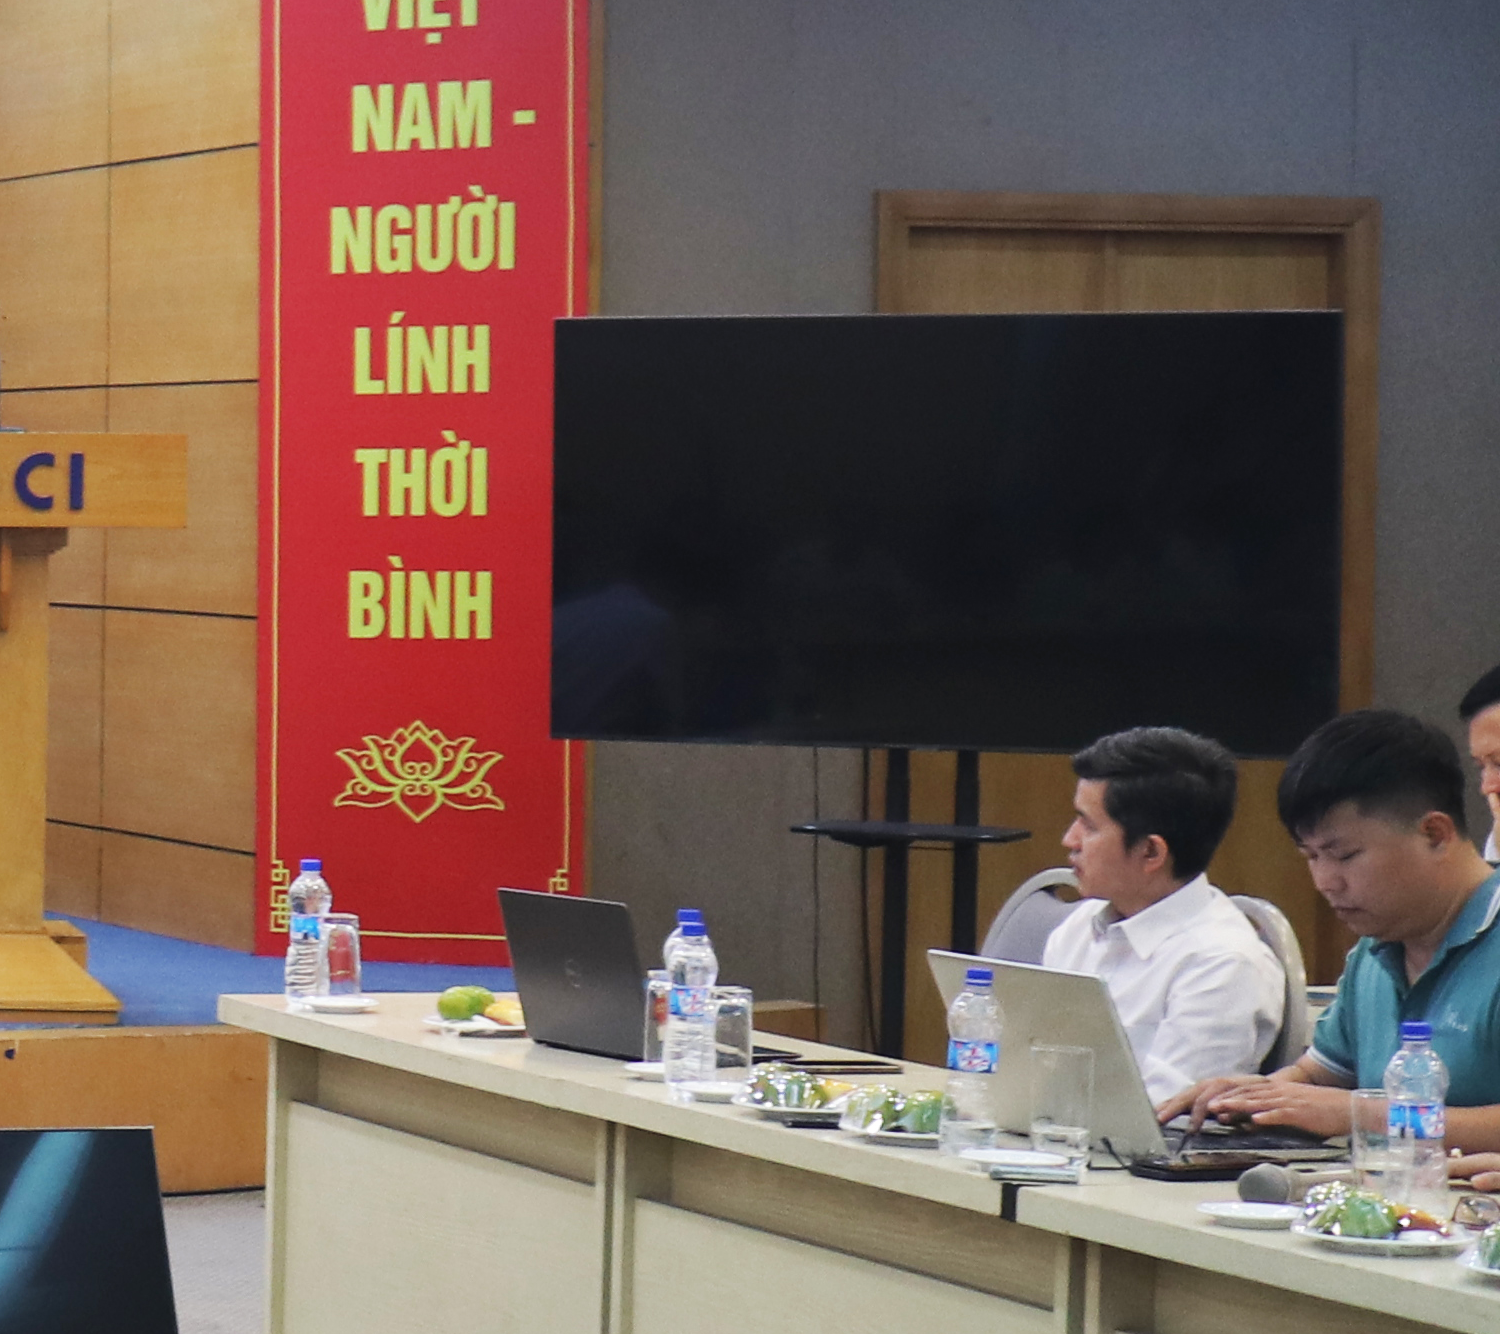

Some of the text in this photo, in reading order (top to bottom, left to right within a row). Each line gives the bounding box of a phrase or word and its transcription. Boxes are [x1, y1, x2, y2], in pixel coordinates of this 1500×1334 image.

[351, 79, 493, 153] NAM
[329, 184, 517, 275] NGƯỜI
[353, 310, 491, 396] LÍNH
[354, 430, 489, 518] THỜI
[347, 555, 493, 641] BÌNH
